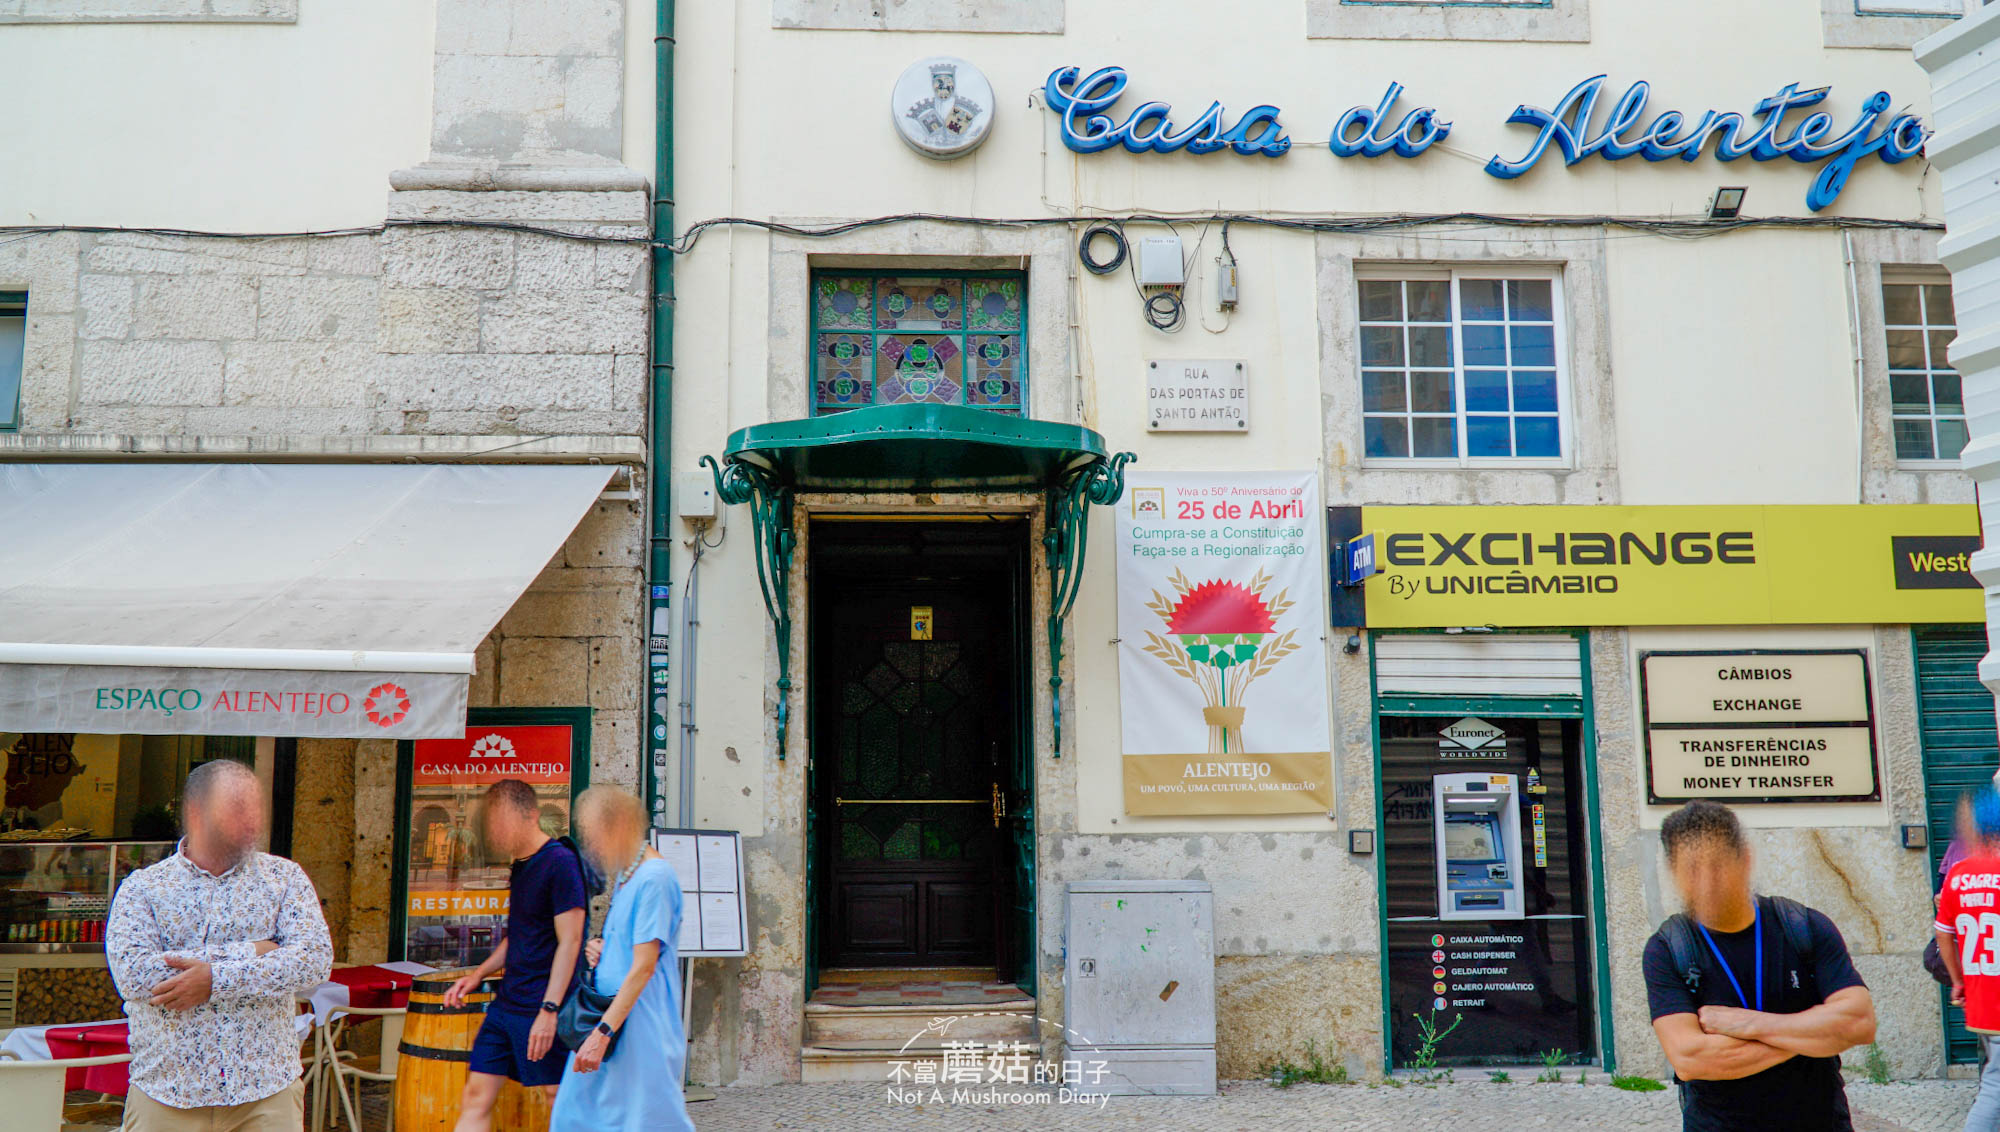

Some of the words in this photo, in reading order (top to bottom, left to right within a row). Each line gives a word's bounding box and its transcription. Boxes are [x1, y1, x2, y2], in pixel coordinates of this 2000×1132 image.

[1044, 65, 1290, 158] Casa
[1329, 80, 1453, 158] do
[1484, 74, 1932, 212] Alentejo
[1184, 368, 1209, 379] RUA
[1150, 387, 1175, 399] DAS
[1179, 387, 1225, 399] PORTAS
[1230, 388, 1245, 399] DE
[1155, 407, 1196, 419] SANTO
[1200, 405, 1241, 419] ANTÃO
[1177, 487, 1199, 496] Viva
[1231, 486, 1287, 496] Aniversário
[1290, 487, 1303, 496] do
[1177, 501, 1205, 519] 25
[1212, 501, 1241, 519] de
[1249, 499, 1304, 519] Abril
[1132, 527, 1207, 541] Cumpra-se
[1210, 530, 1219, 539] a
[1223, 526, 1304, 539] Constituição
[1133, 544, 1187, 559] Faça-se
[1191, 548, 1199, 556] a
[1204, 543, 1305, 559] Regionalização
[1353, 545, 1372, 571] ATM
[1387, 575, 1420, 600] By
[1718, 667, 1792, 680] CÂMBIOS
[96, 688, 202, 717] ESPAÇO
[212, 690, 350, 718] ALENTEJO
[1713, 699, 1802, 711] EXCHANGE
[1450, 726, 1495, 738] Euronet
[1680, 738, 1827, 752] TRANSFERÊNCIAS
[1705, 756, 1725, 767] DE
[1731, 755, 1810, 767] DINHEIRO
[420, 764, 461, 775] CASA
[465, 763, 487, 775] DO
[490, 762, 565, 777] ALENTEJO
[1182, 763, 1271, 780] ALENTEJO
[1140, 785, 1156, 793] UM
[1188, 785, 1210, 793] UMA
[1212, 784, 1257, 792] CULTURA,
[1259, 783, 1279, 791] UMA
[1281, 782, 1316, 791] REGIÃO
[1683, 777, 1742, 789] MONEY
[1748, 776, 1834, 788] TRANSFER
[1960, 874, 2000, 891] SAGRE
[1474, 935, 1524, 943] AUTOMÁTICO
[1955, 912, 2000, 976] 23
[1450, 952, 1472, 960] CASH
[1451, 967, 1508, 975] GELDAUTOMAT
[1452, 983, 1483, 991] CAJERO
[1484, 982, 1534, 991] AUTOMÁTICO
[1453, 999, 1485, 1007] RETRAIT
